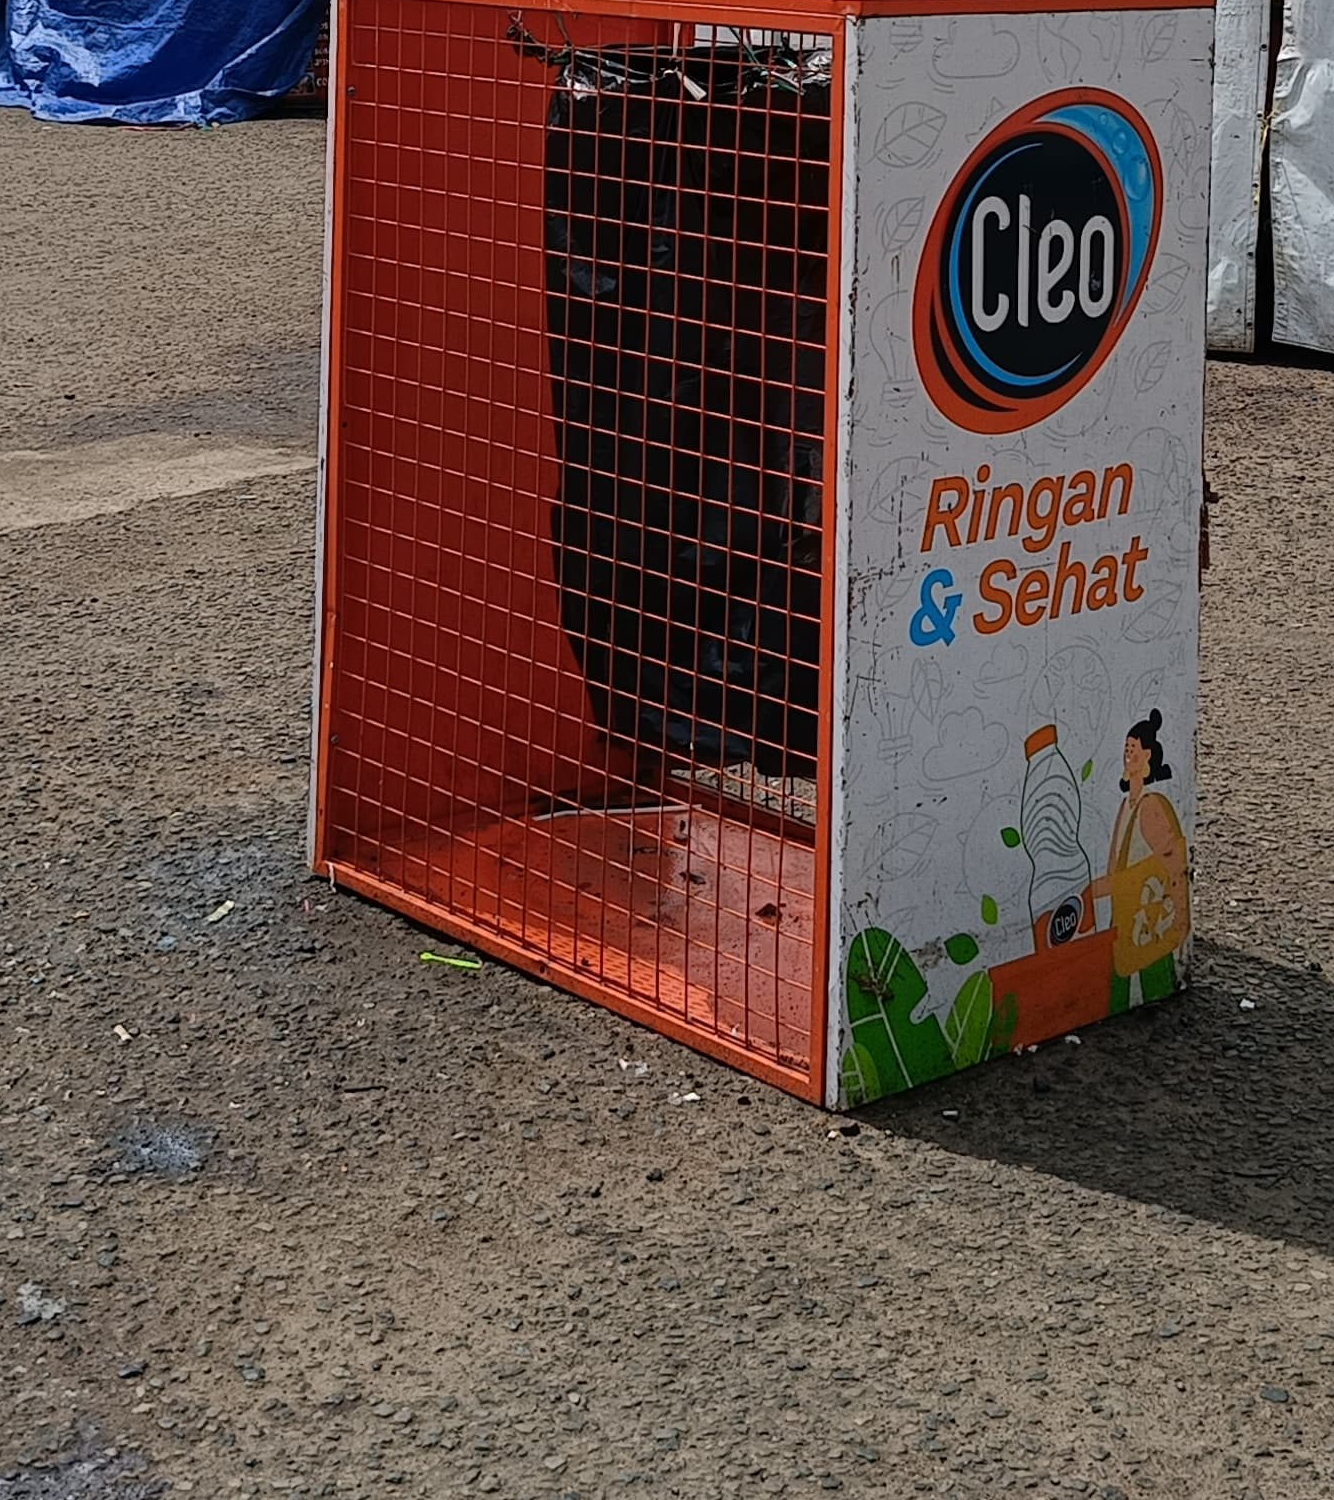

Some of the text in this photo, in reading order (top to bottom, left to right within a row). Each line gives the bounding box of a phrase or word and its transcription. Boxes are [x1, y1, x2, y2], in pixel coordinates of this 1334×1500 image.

[972, 194, 1114, 332] Cleo
[920, 462, 1134, 554] Ringan
[909, 535, 1149, 647] & Sehat
[1055, 912, 1076, 936] Cleo
